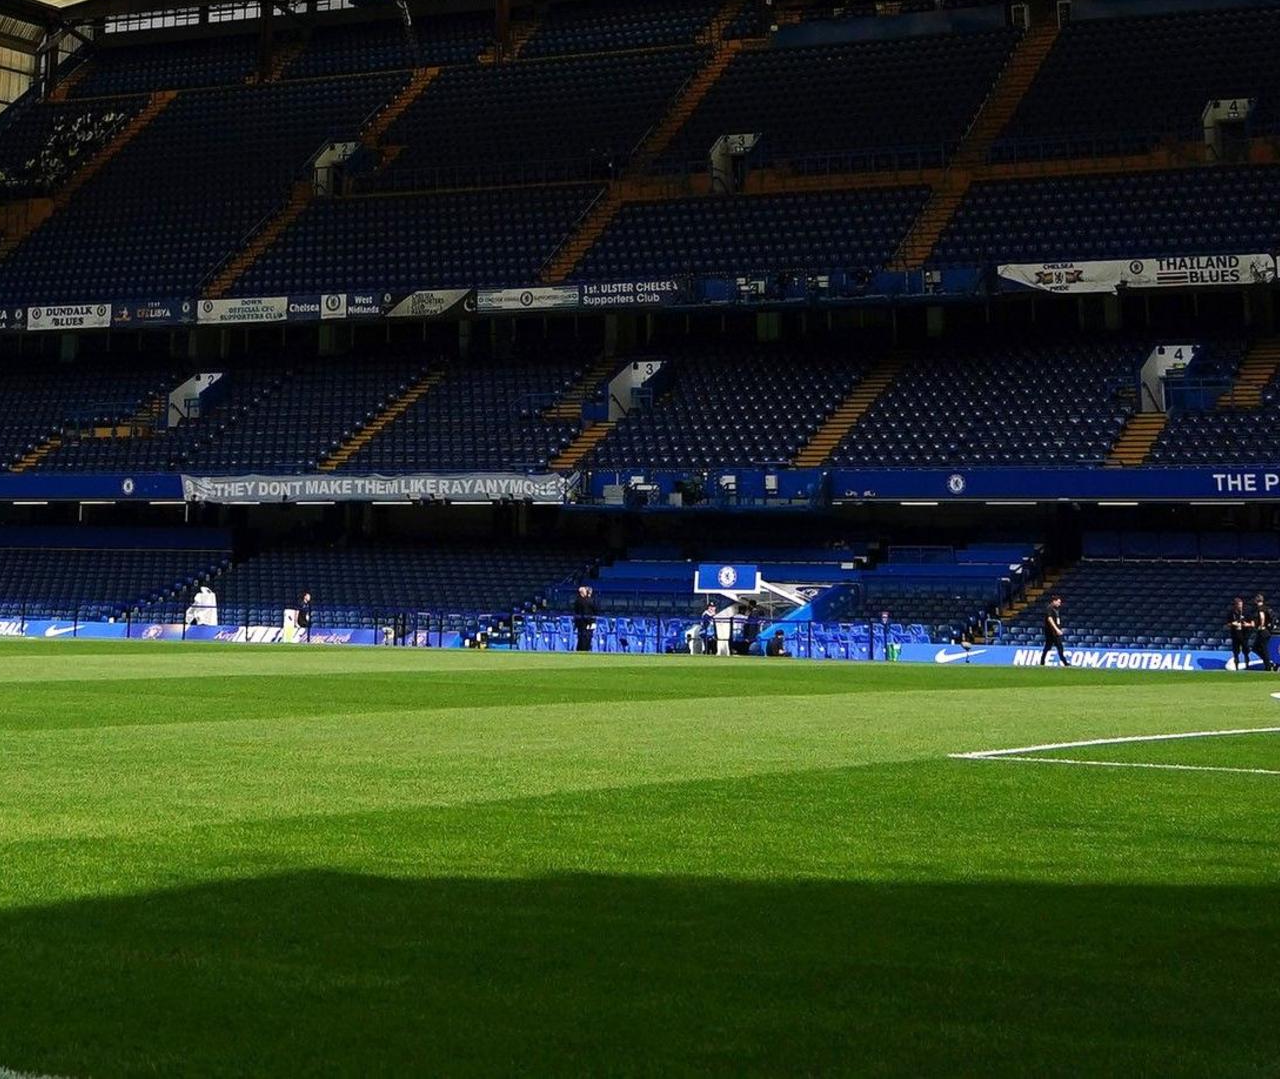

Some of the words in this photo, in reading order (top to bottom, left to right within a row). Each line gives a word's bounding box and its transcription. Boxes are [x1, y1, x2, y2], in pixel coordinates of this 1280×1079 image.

[1229, 100, 1237, 111] 4
[1156, 256, 1239, 271] THAILAND
[1189, 270, 1240, 283] BLUES
[601, 283, 634, 294] ULSTER
[354, 295, 373, 304] West
[583, 295, 634, 306] Supporters
[636, 293, 660, 303] Club
[46, 306, 93, 317] DUNDALK
[289, 303, 320, 312] Chelsea
[53, 317, 84, 327] BLUES
[1174, 348, 1183, 360] 4
[646, 363, 654, 375] 3
[208, 375, 214, 385] 2
[213, 482, 255, 497] THEY
[305, 479, 352, 495] MAKE
[354, 479, 399, 494] THEM
[400, 480, 437, 495] LIKE
[438, 480, 473, 495] RAY
[1212, 473, 1257, 492] THE
